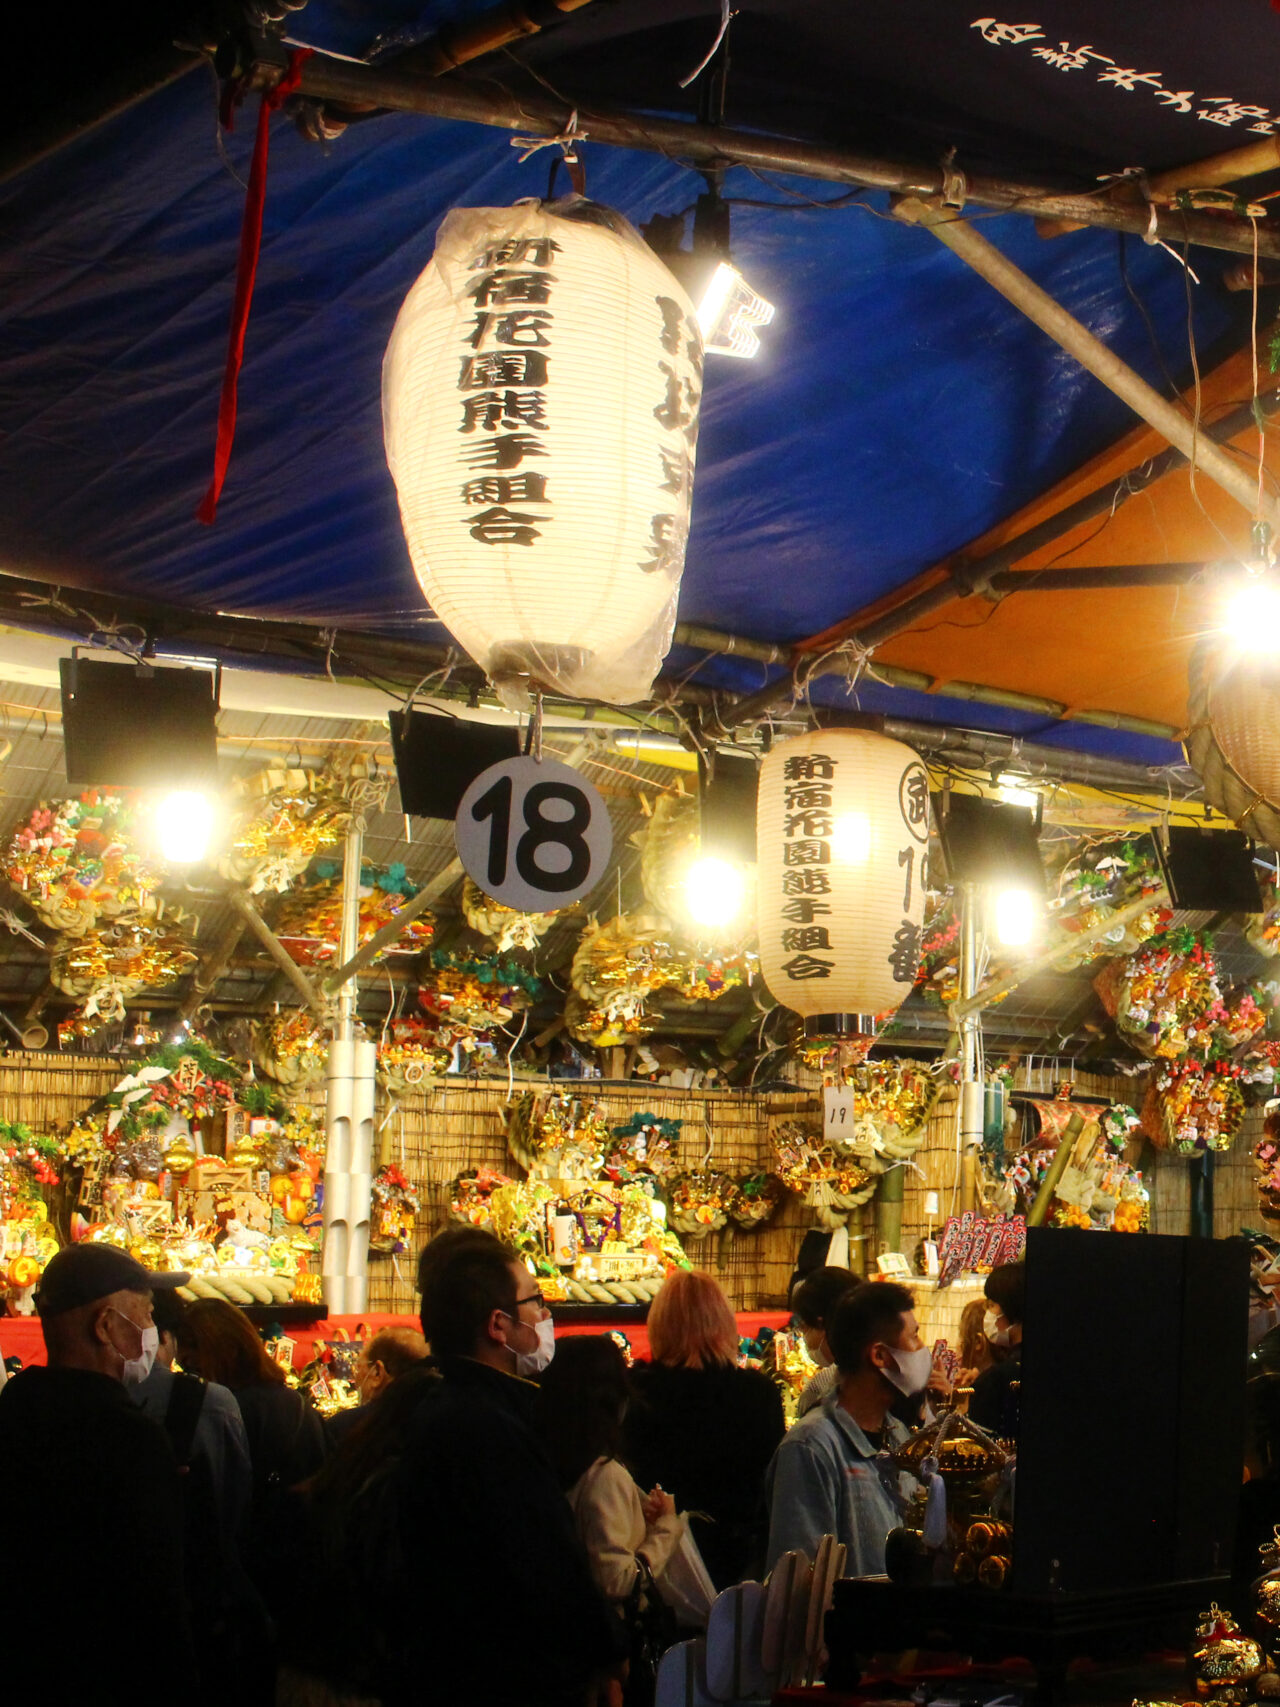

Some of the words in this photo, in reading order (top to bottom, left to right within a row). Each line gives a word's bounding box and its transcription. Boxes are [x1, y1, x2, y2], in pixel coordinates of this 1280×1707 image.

[456, 237, 565, 546] 新宿花園熊手組合
[471, 775, 592, 893] 18
[781, 753, 839, 981] 新宿花園熊手組合
[829, 1106, 848, 1125] 19
